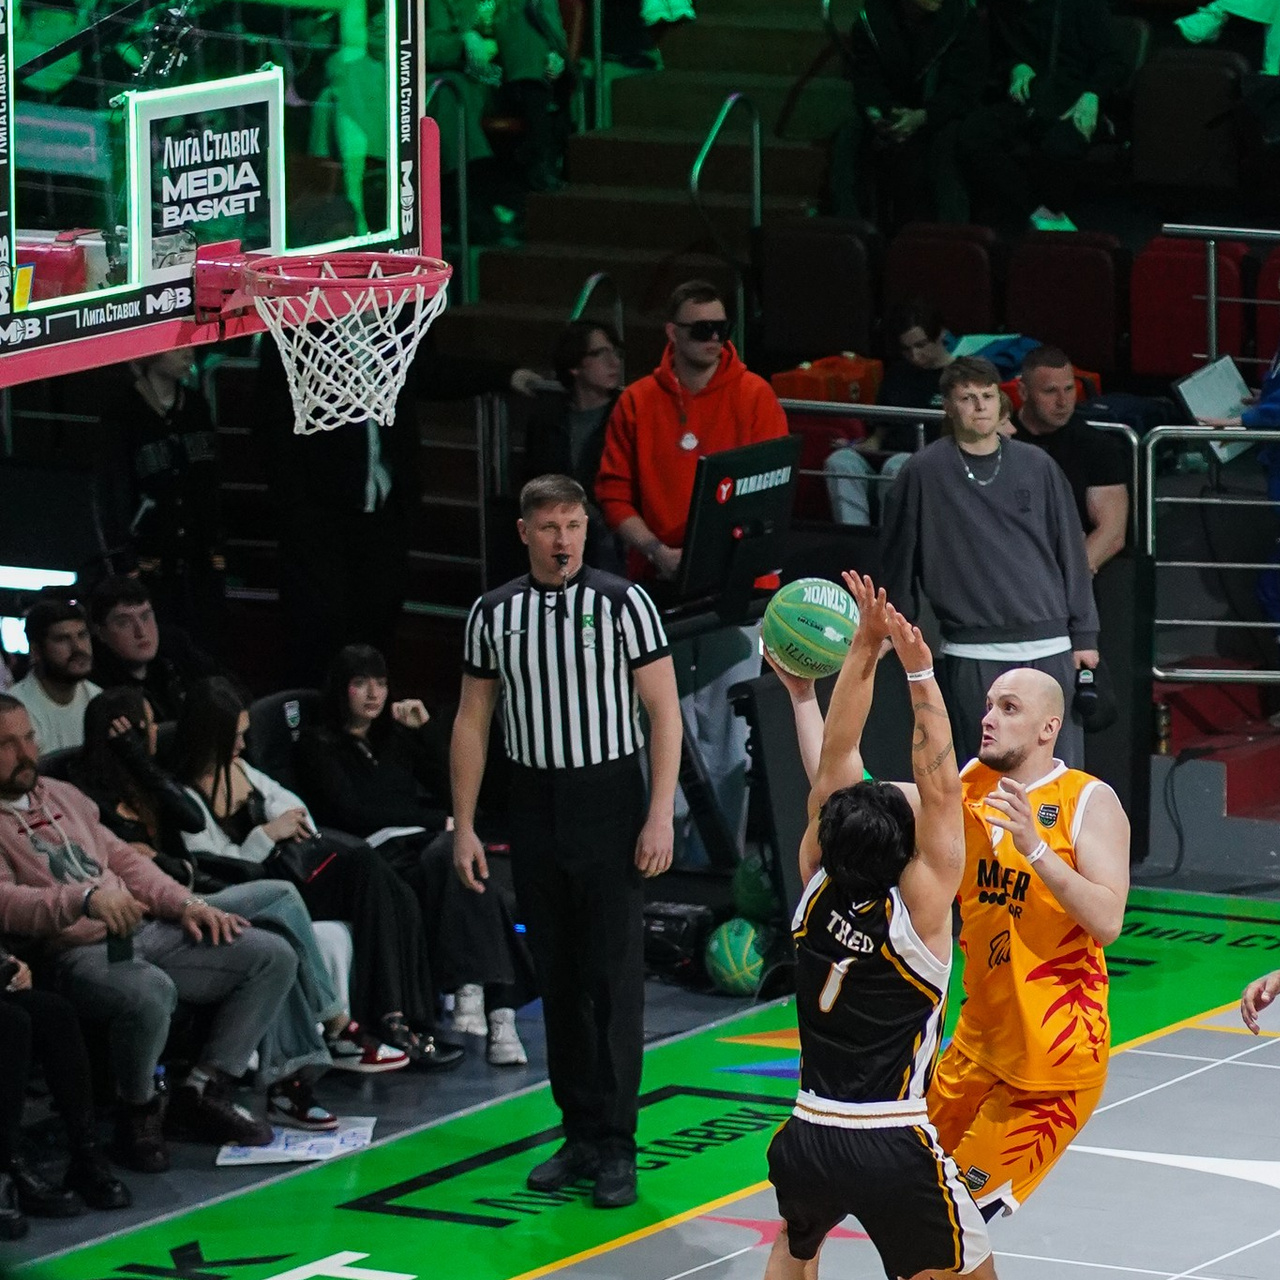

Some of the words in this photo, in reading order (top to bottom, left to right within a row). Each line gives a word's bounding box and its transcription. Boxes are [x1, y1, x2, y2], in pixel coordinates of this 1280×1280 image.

[162, 161, 260, 203] MEDIA
[163, 190, 261, 228] BASKET
[735, 466, 792, 496] YAMAGUCHI
[802, 585, 848, 614] STAVOK
